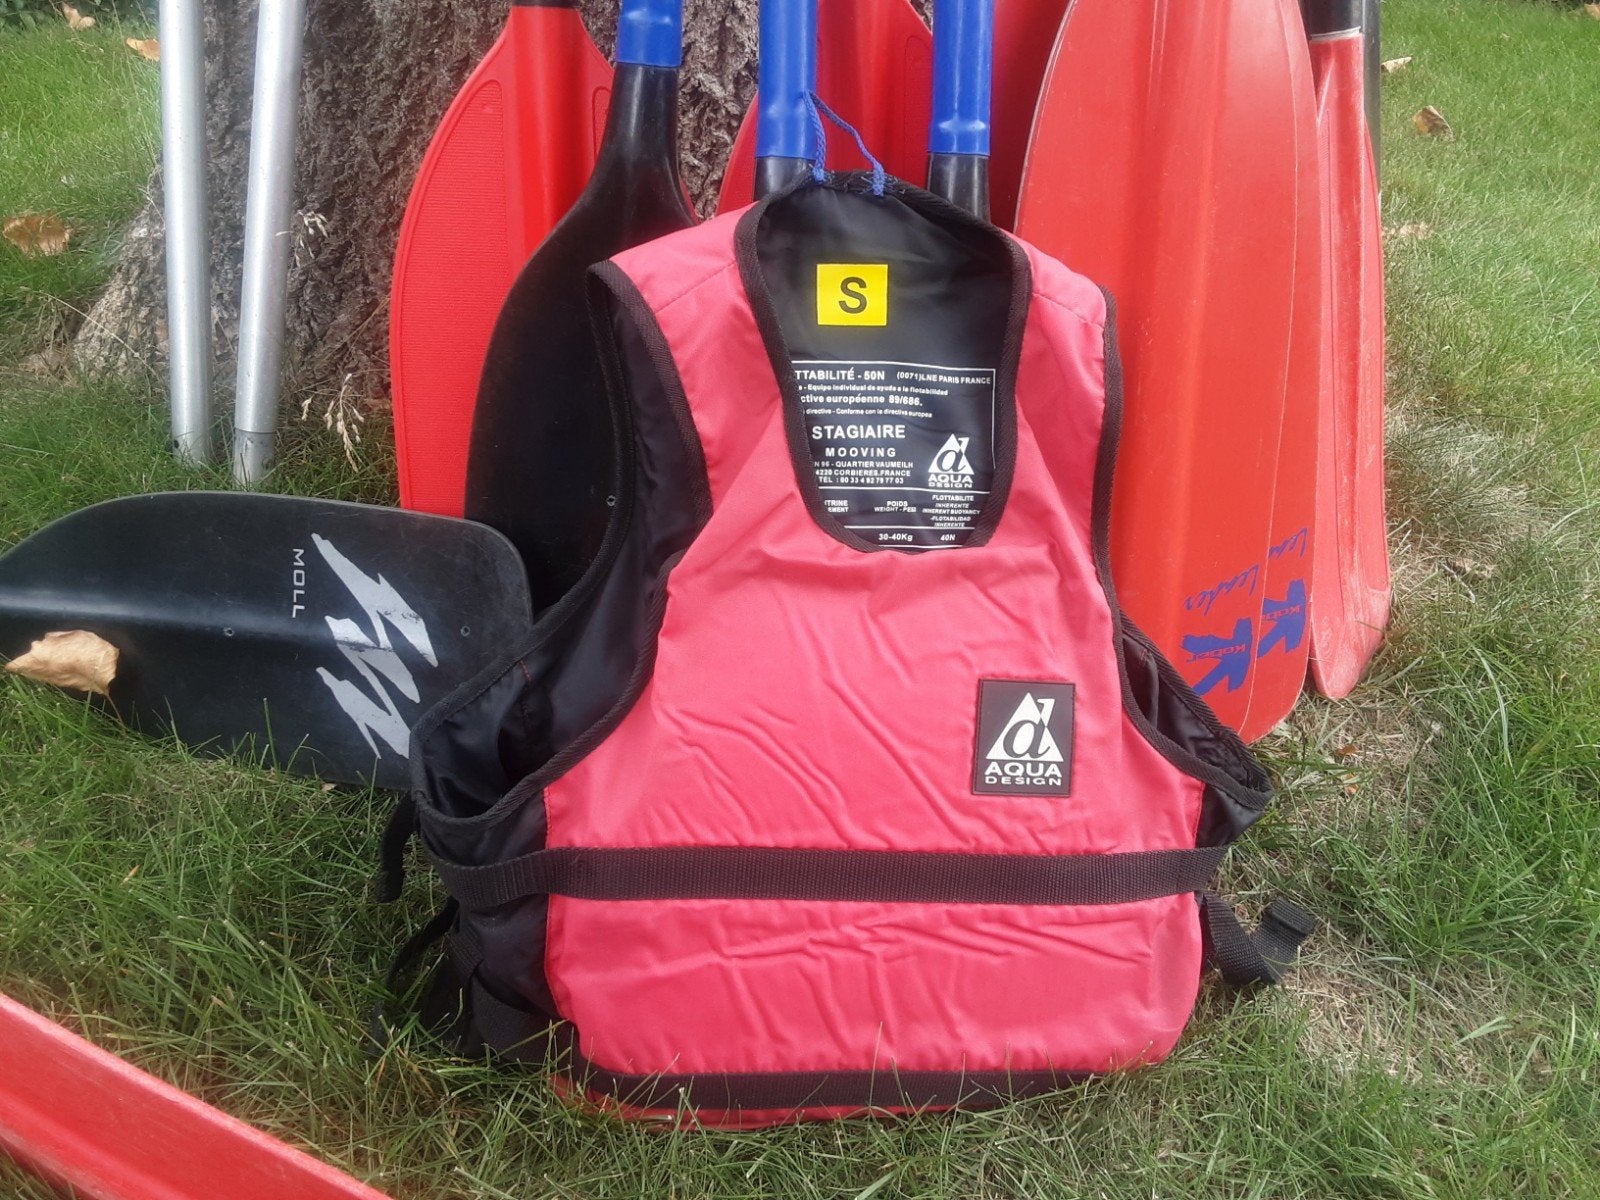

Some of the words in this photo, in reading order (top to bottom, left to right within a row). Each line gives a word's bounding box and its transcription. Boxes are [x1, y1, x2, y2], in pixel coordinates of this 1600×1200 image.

[839, 276, 867, 314] S
[863, 371, 885, 380] 50N
[938, 375, 959, 384] PARIS
[960, 376, 991, 384] FRANCE
[826, 393, 885, 404] européenne
[812, 424, 906, 440] STAGIAIRE
[825, 446, 896, 457] MOOVING
[835, 460, 875, 469] QUARTIER
[928, 473, 974, 484] AQUA
[940, 533, 956, 541] 40N
[292, 548, 306, 618] MOLL
[984, 761, 1063, 778] AQUA
[984, 776, 1062, 786] DESIGN
